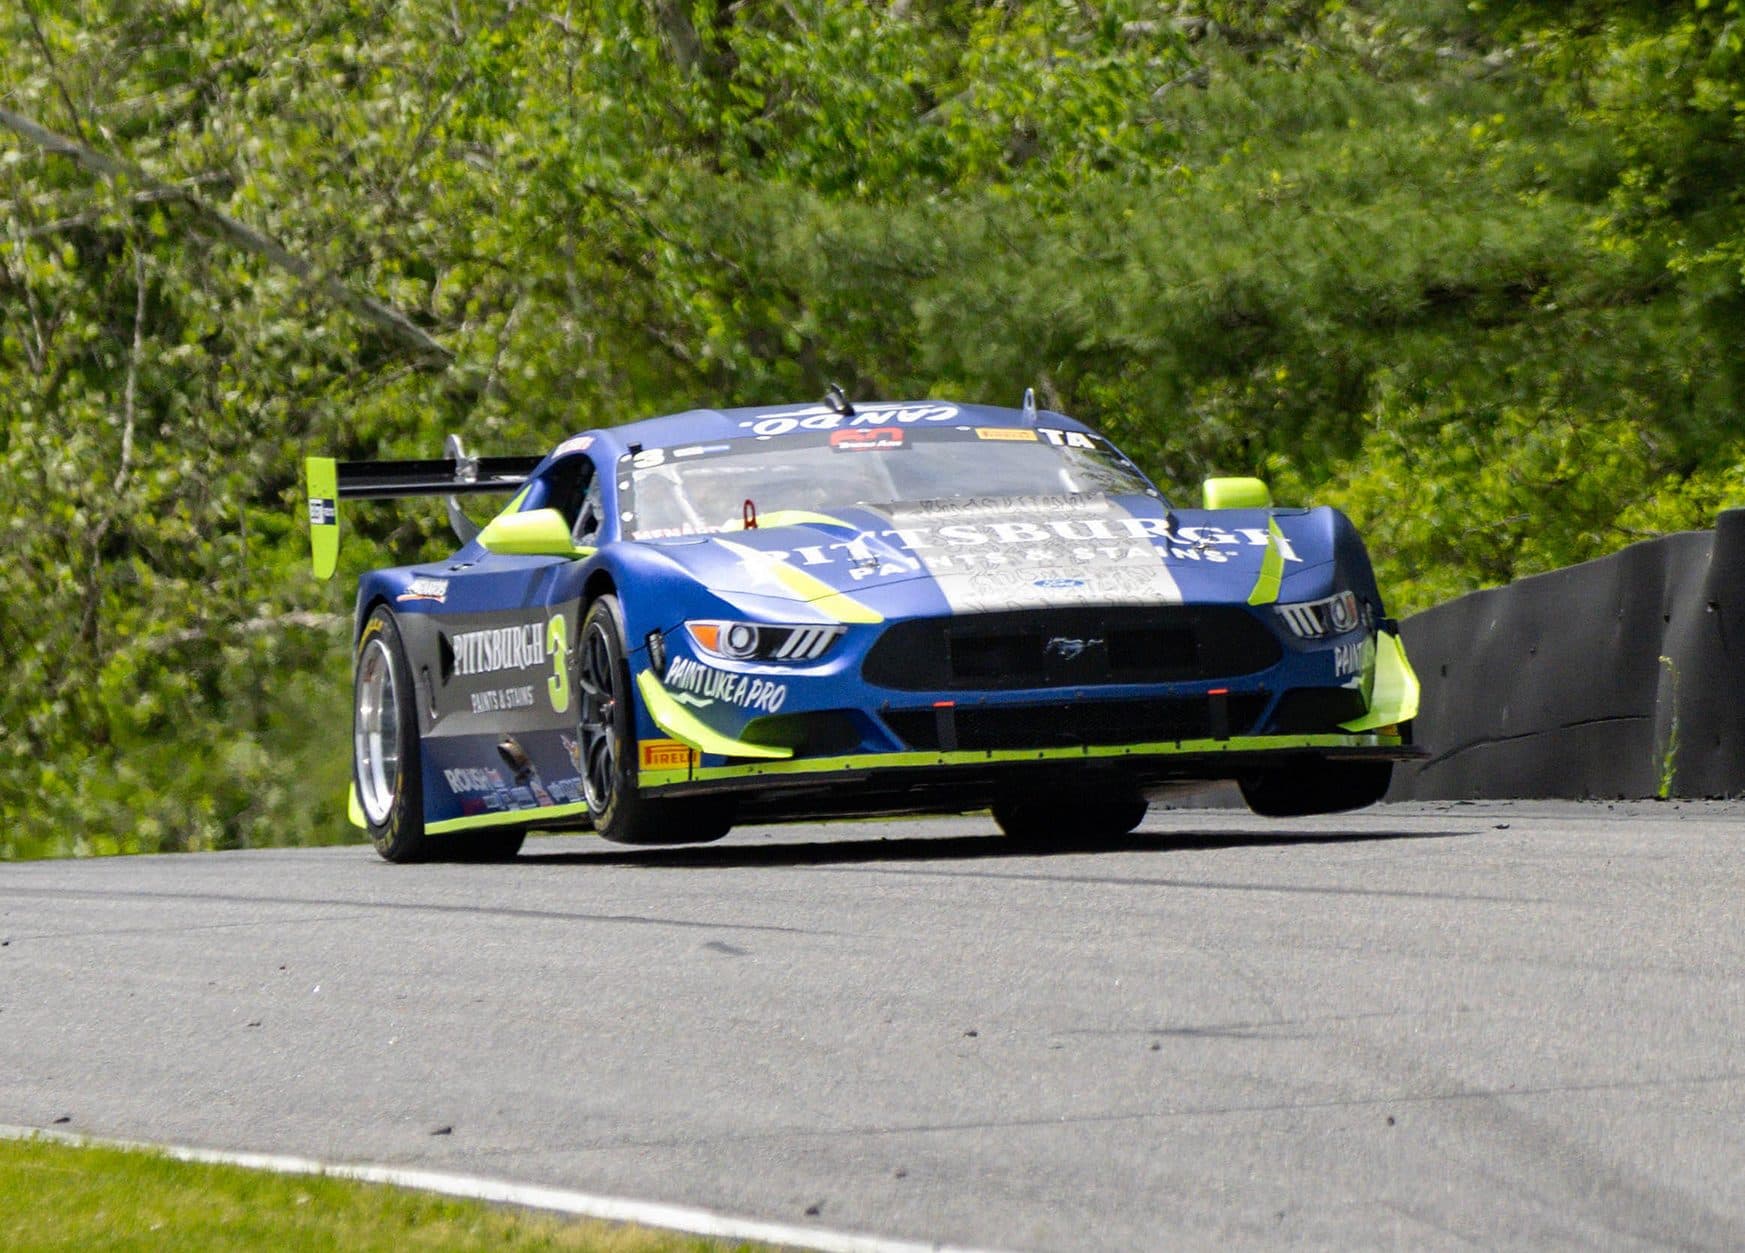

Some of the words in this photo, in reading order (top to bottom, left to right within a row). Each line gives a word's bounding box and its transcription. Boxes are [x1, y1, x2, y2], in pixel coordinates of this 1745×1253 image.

[849, 406, 958, 426] CAN
[1038, 428, 1096, 449] TA
[633, 448, 665, 468] 3
[849, 552, 1008, 580] PAINTS
[1025, 547, 1056, 561] &
[453, 622, 544, 676] PITTSBURGH
[546, 614, 569, 713] 3
[664, 655, 706, 694] PAINT
[703, 668, 739, 702] LIKE
[732, 676, 749, 707] A
[743, 679, 787, 713] PRO
[471, 690, 499, 713] PAINTS
[644, 744, 697, 765] PIRELI
